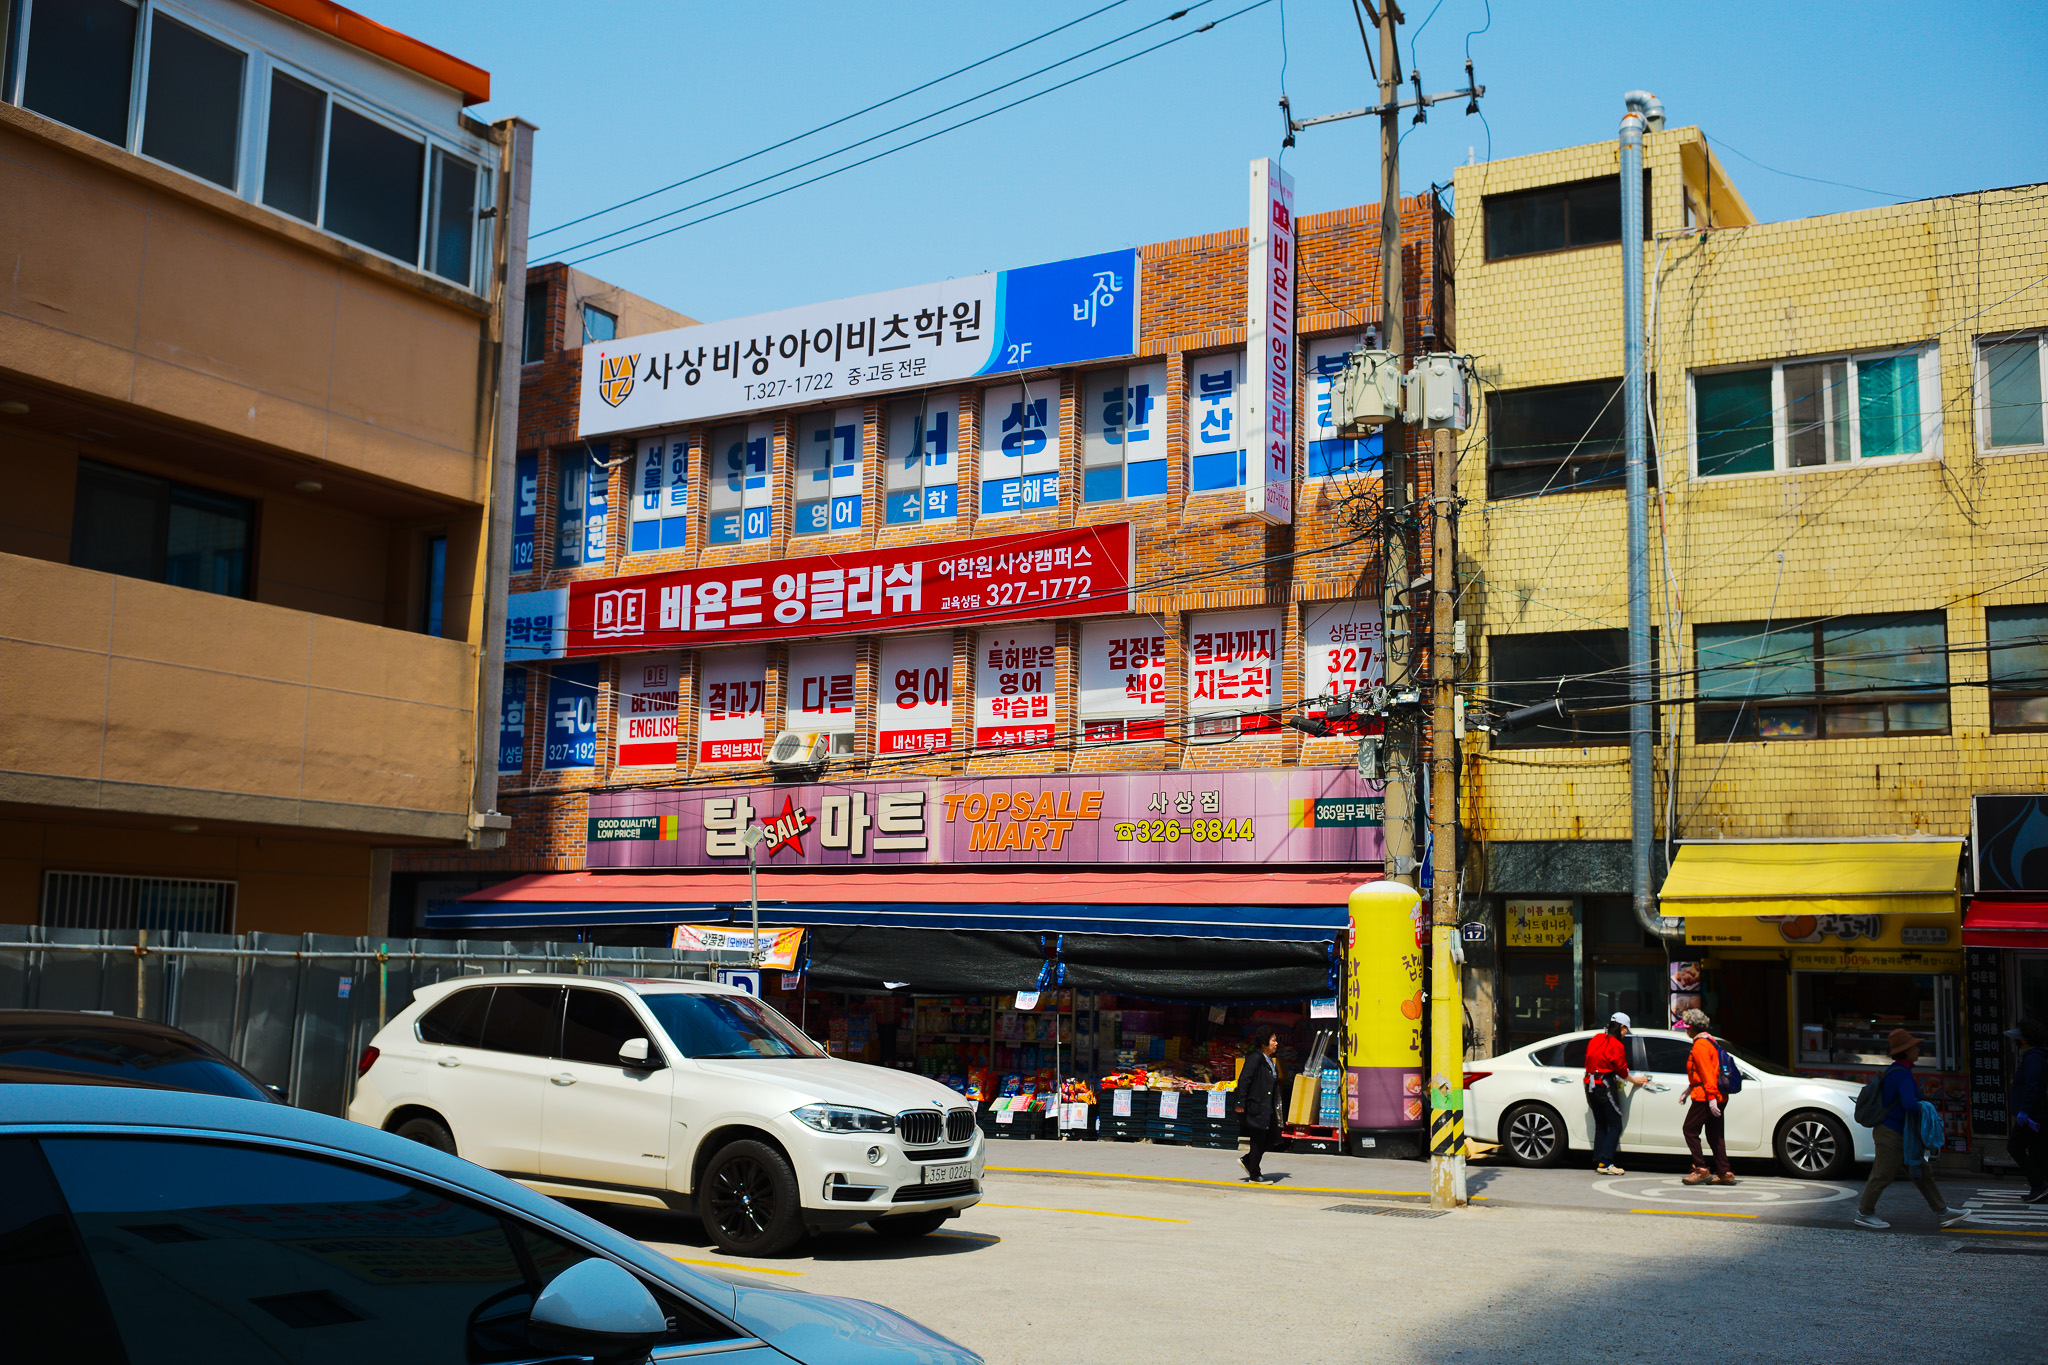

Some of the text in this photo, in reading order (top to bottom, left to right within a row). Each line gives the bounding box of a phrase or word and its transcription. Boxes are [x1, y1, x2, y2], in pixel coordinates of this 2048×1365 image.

[1007, 342, 1031, 366] 2F
[898, 357, 927, 380] 전문
[744, 372, 834, 401] T.327-1722
[1200, 370, 1233, 443] 부산
[727, 384, 1154, 492] 연 고 서 성 한
[643, 446, 662, 510] 서울대
[670, 442, 689, 507] 카이스트
[903, 490, 948, 518] 수학
[1001, 476, 1060, 507] 문해력
[723, 512, 764, 538] 국어
[812, 501, 852, 528] 영어
[938, 545, 1093, 582] 어학원 사상캠퍼스
[659, 561, 922, 631] 비욘드 잉글리쉬
[940, 575, 1092, 611] 교육상담 327-1772
[987, 645, 1055, 671] 특허받은
[1193, 629, 1276, 665] 결과까지
[802, 674, 854, 715] 다른
[895, 666, 949, 710] 영어
[999, 671, 1042, 695] 영어
[554, 695, 597, 735] 국어
[631, 690, 679, 713] BEYOND
[991, 695, 1048, 719] 학습법
[629, 717, 678, 739] ENGLISH
[548, 741, 595, 761] 327-192
[711, 743, 763, 759] 토익브릿지
[943, 790, 1104, 823] TOPSALE
[597, 819, 619, 829] GOOD
[597, 829, 612, 839] LOW
[702, 795, 754, 857] 탑
[763, 806, 809, 849] SALE
[819, 791, 927, 857] 마트
[968, 821, 1074, 852] MART
[1136, 817, 1255, 844] 326-8844
[1527, 906, 1543, 916] 이름
[1467, 931, 1482, 939] 17
[1840, 955, 1870, 966] 100%
[930, 1166, 968, 1181] 35보 0226
